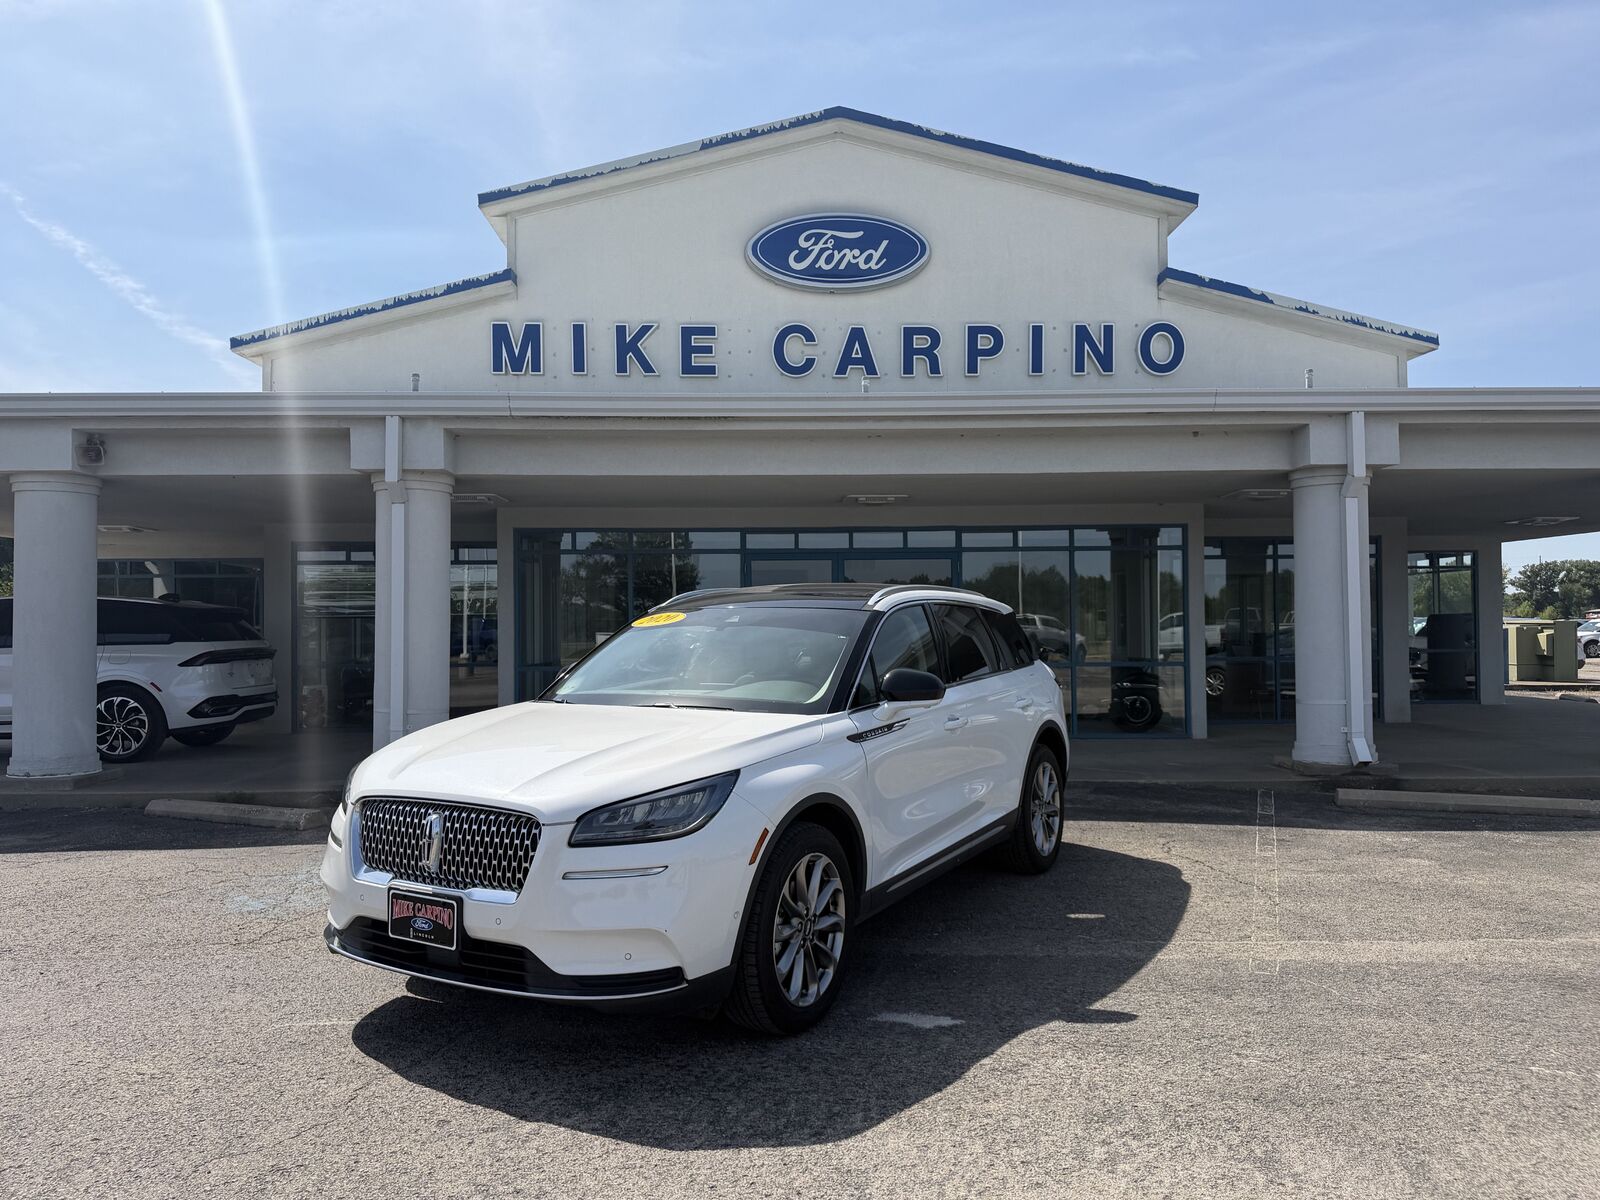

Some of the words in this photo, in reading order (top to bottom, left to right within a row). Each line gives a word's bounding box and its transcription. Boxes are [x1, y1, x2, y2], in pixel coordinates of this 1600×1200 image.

[788, 229, 889, 270] Ford
[491, 322, 718, 377] MIKE
[773, 322, 1187, 377] CARPINO
[862, 727, 888, 738] CORSAIR
[392, 899, 414, 919] MIKE
[415, 903, 454, 930] CARPINO
[414, 919, 429, 929] Ford
